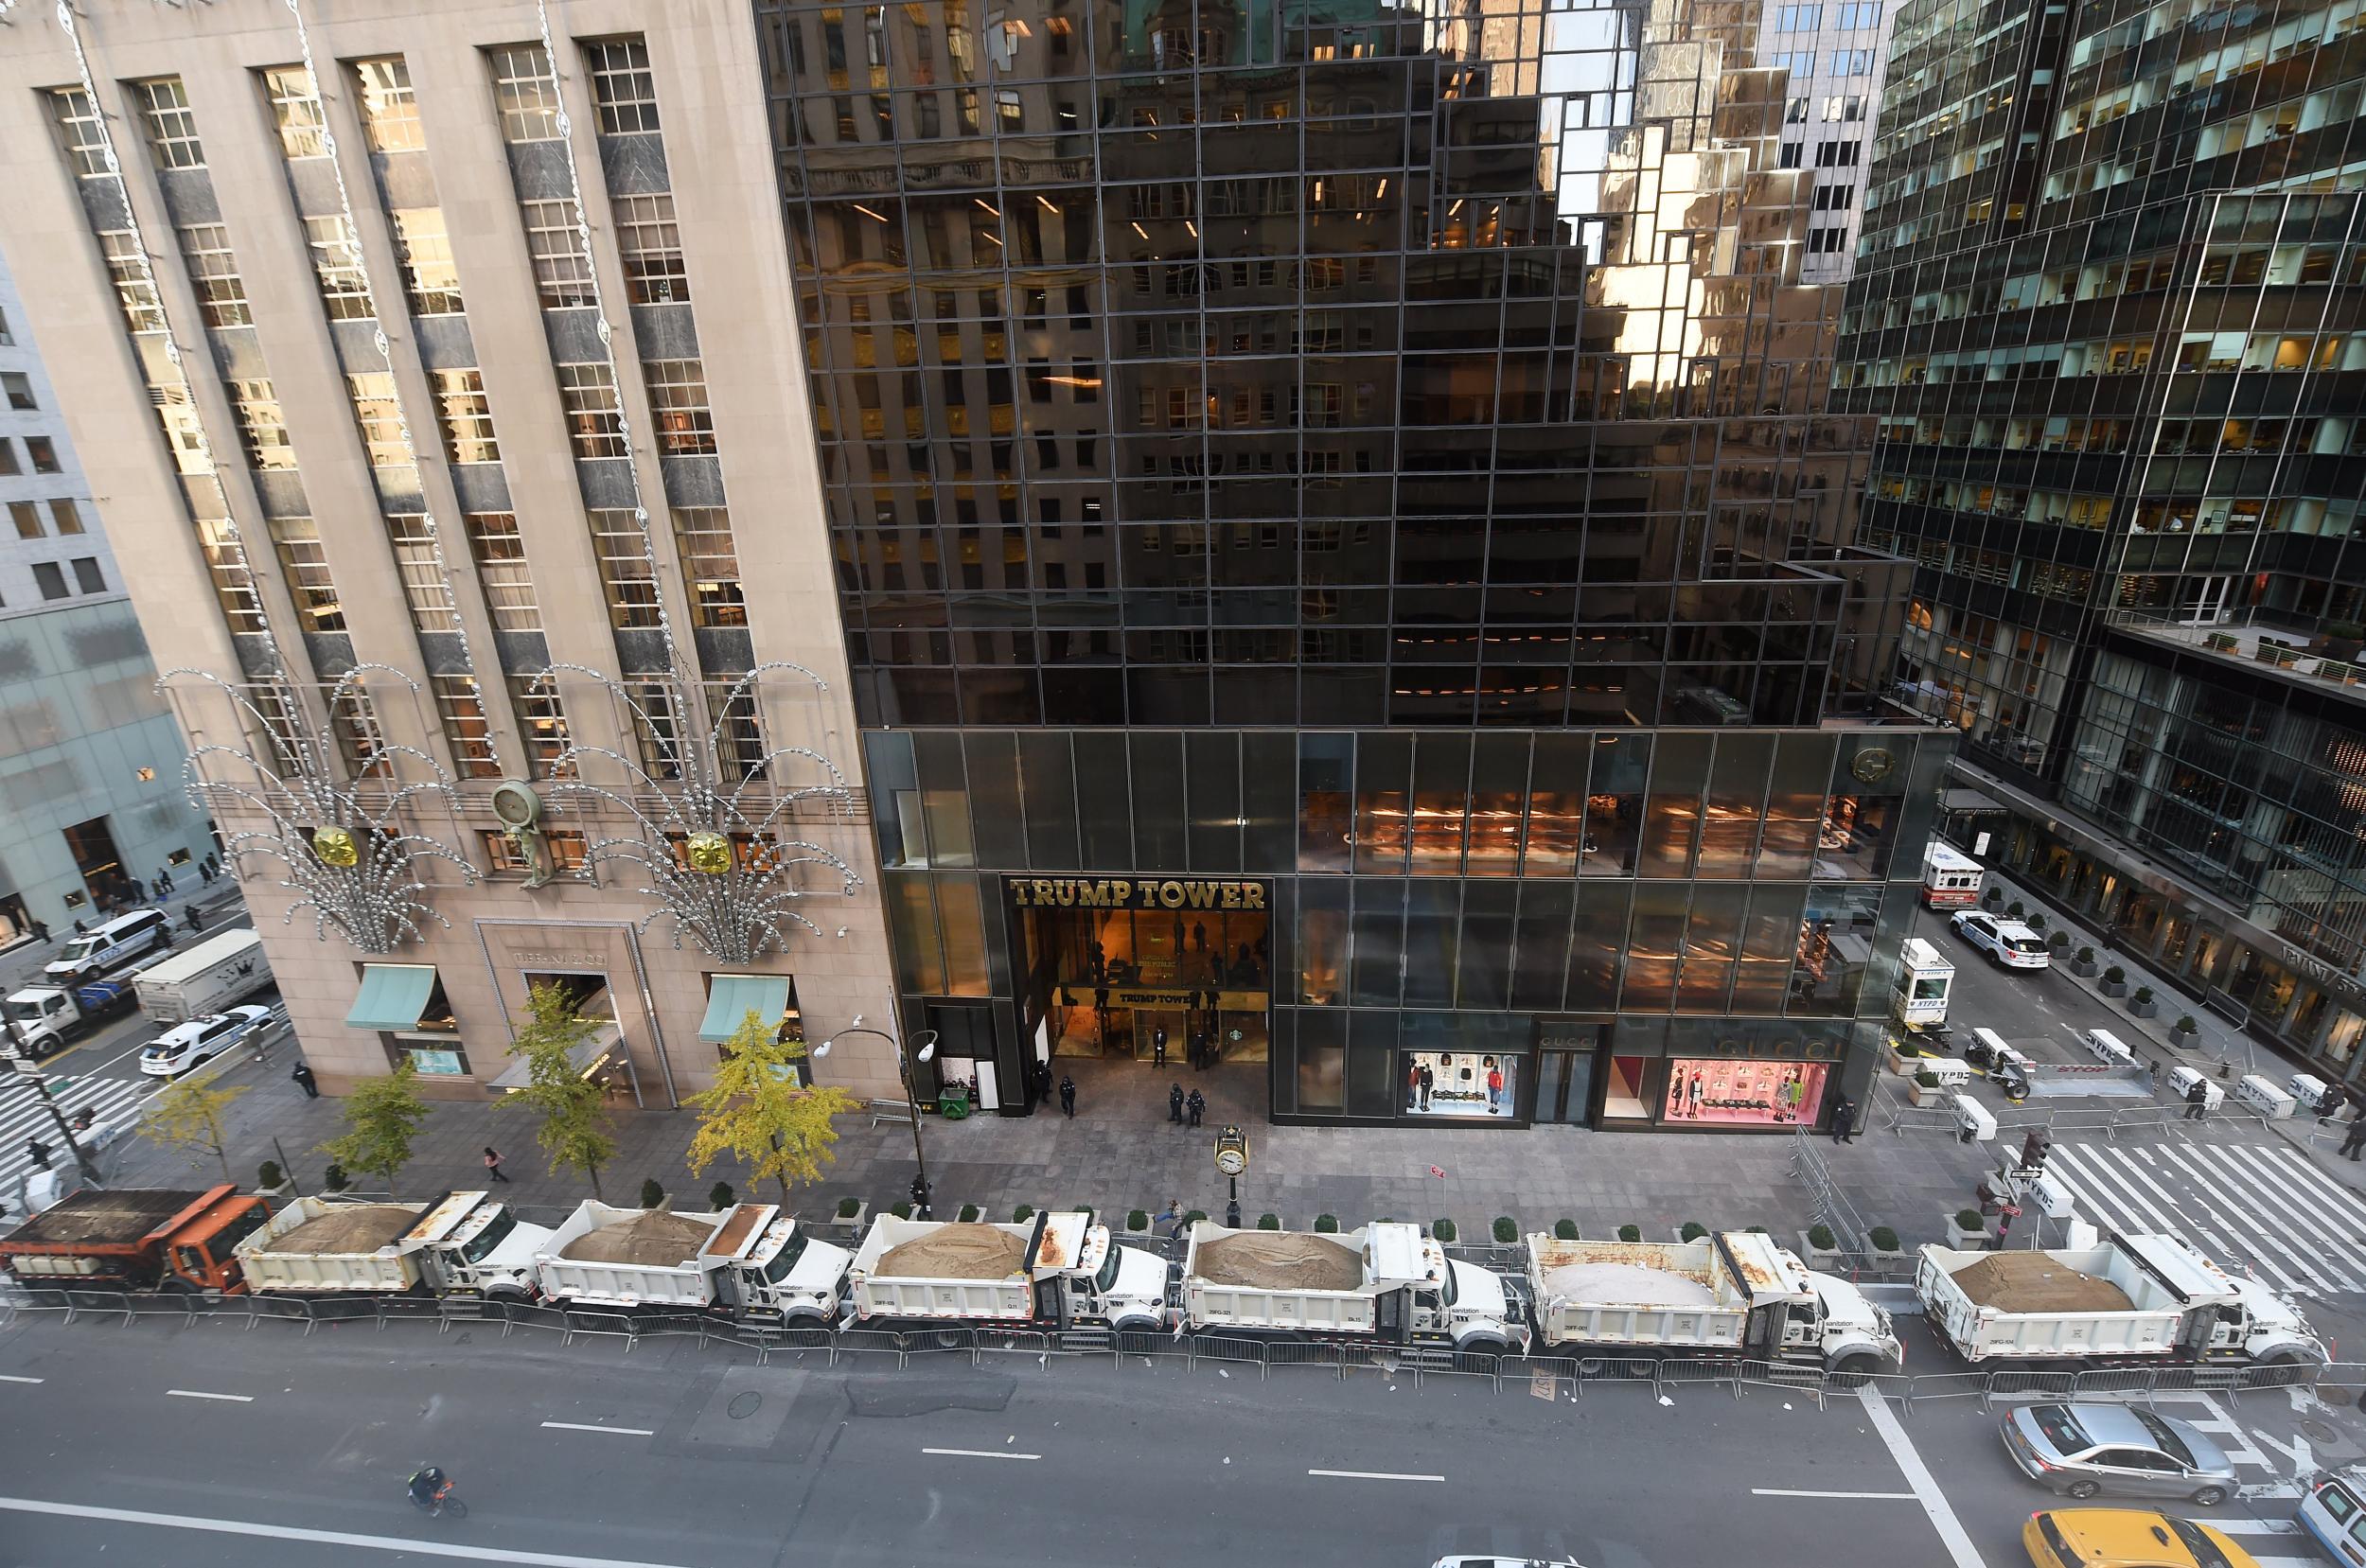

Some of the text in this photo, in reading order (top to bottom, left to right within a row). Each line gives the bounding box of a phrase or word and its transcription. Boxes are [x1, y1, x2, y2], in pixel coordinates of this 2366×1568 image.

[1009, 878, 1265, 909] TRUMP TOWER
[1120, 995, 1190, 1004] TRUMP TOWE
[1541, 1037, 1598, 1047] GUCCI
[1718, 1040, 1842, 1059] GUCCI
[2090, 1036, 2112, 1058] NYPD
